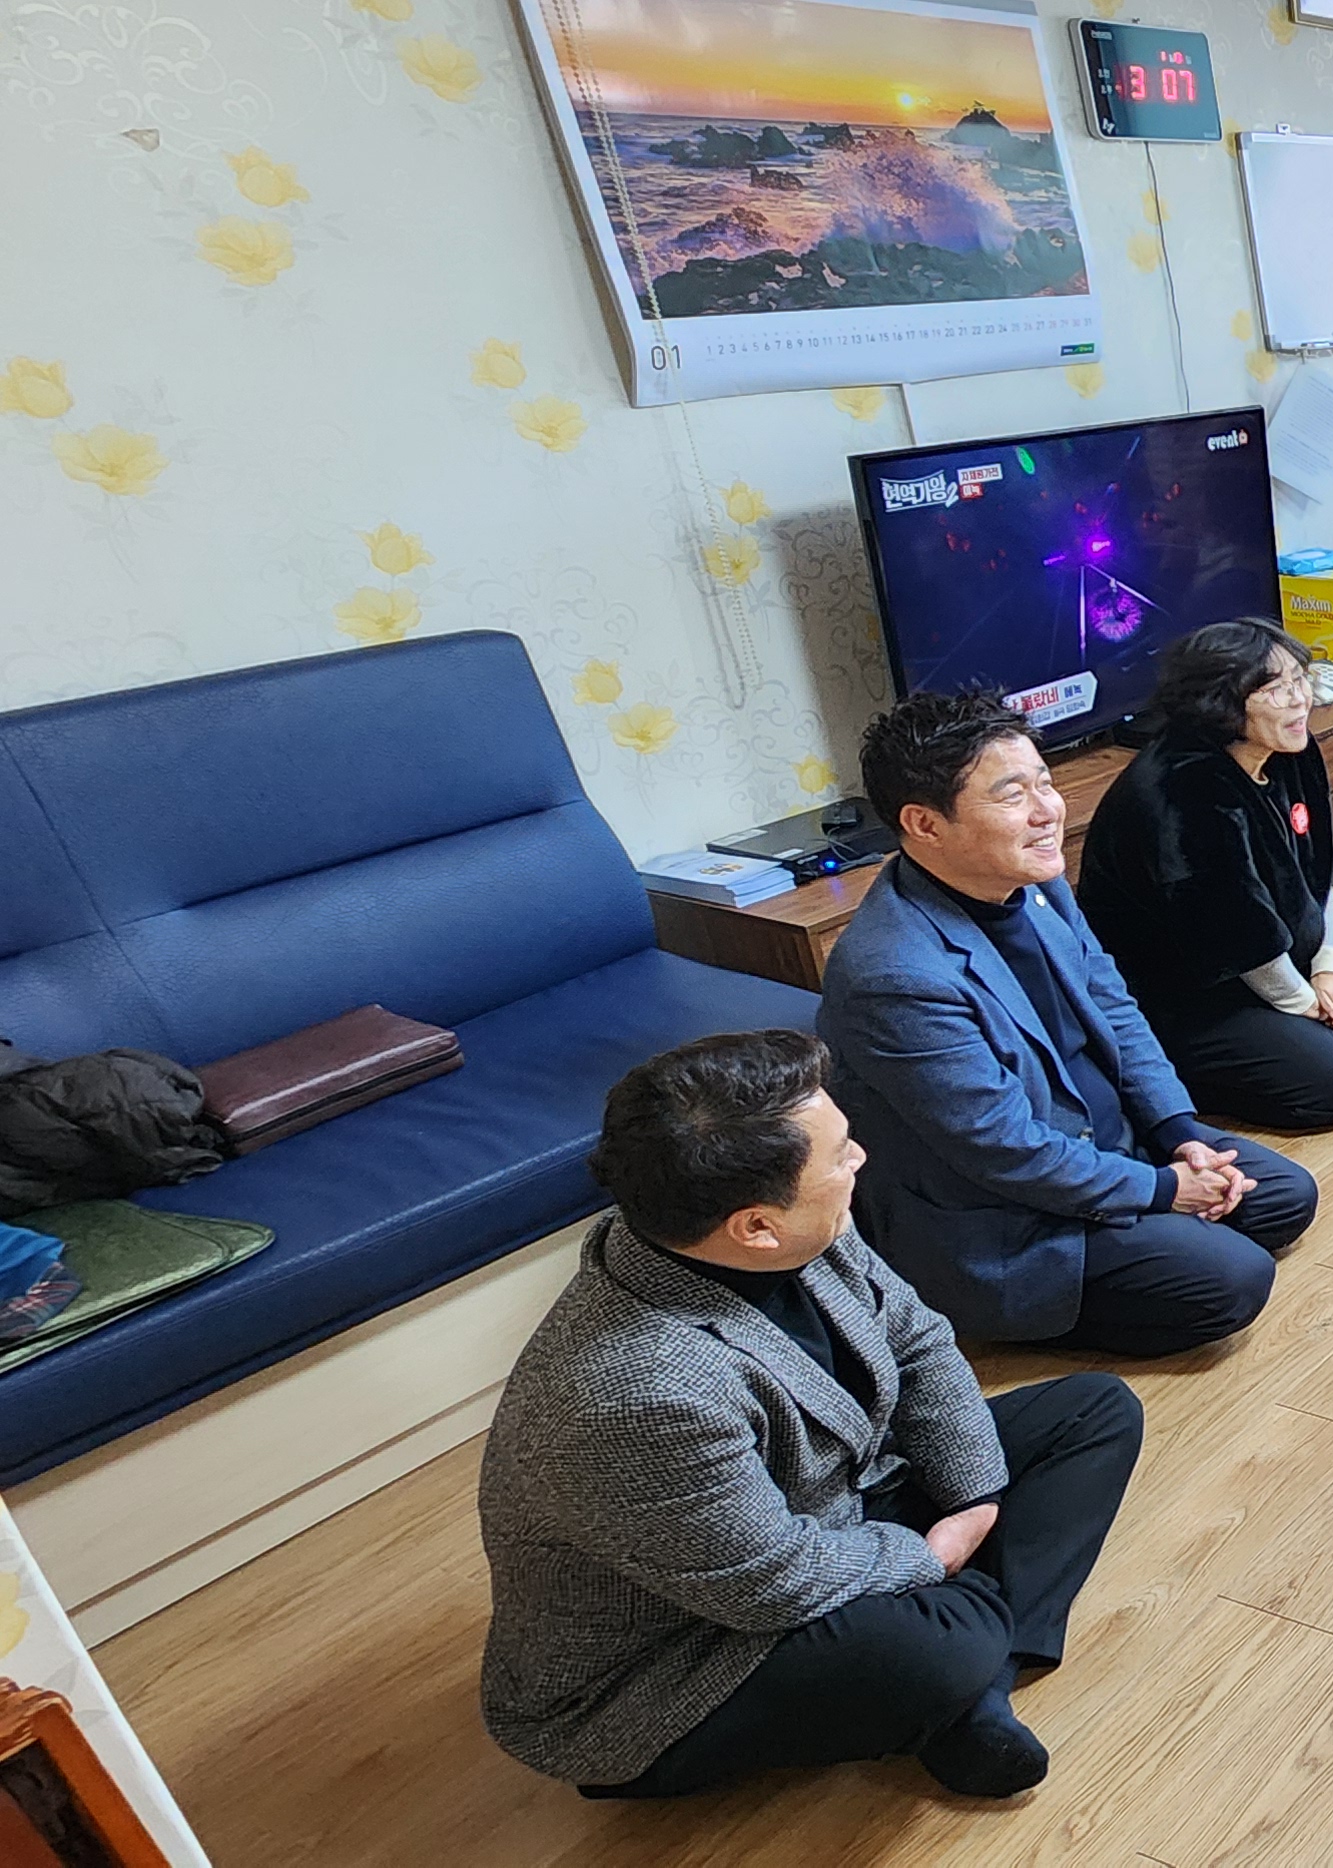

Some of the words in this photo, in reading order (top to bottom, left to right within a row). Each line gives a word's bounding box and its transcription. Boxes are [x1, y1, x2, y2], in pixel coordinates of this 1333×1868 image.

[1129, 65, 1146, 100] 3
[1161, 68, 1196, 103] 07
[651, 344, 682, 371] 01
[1290, 595, 1333, 612] Maxim
